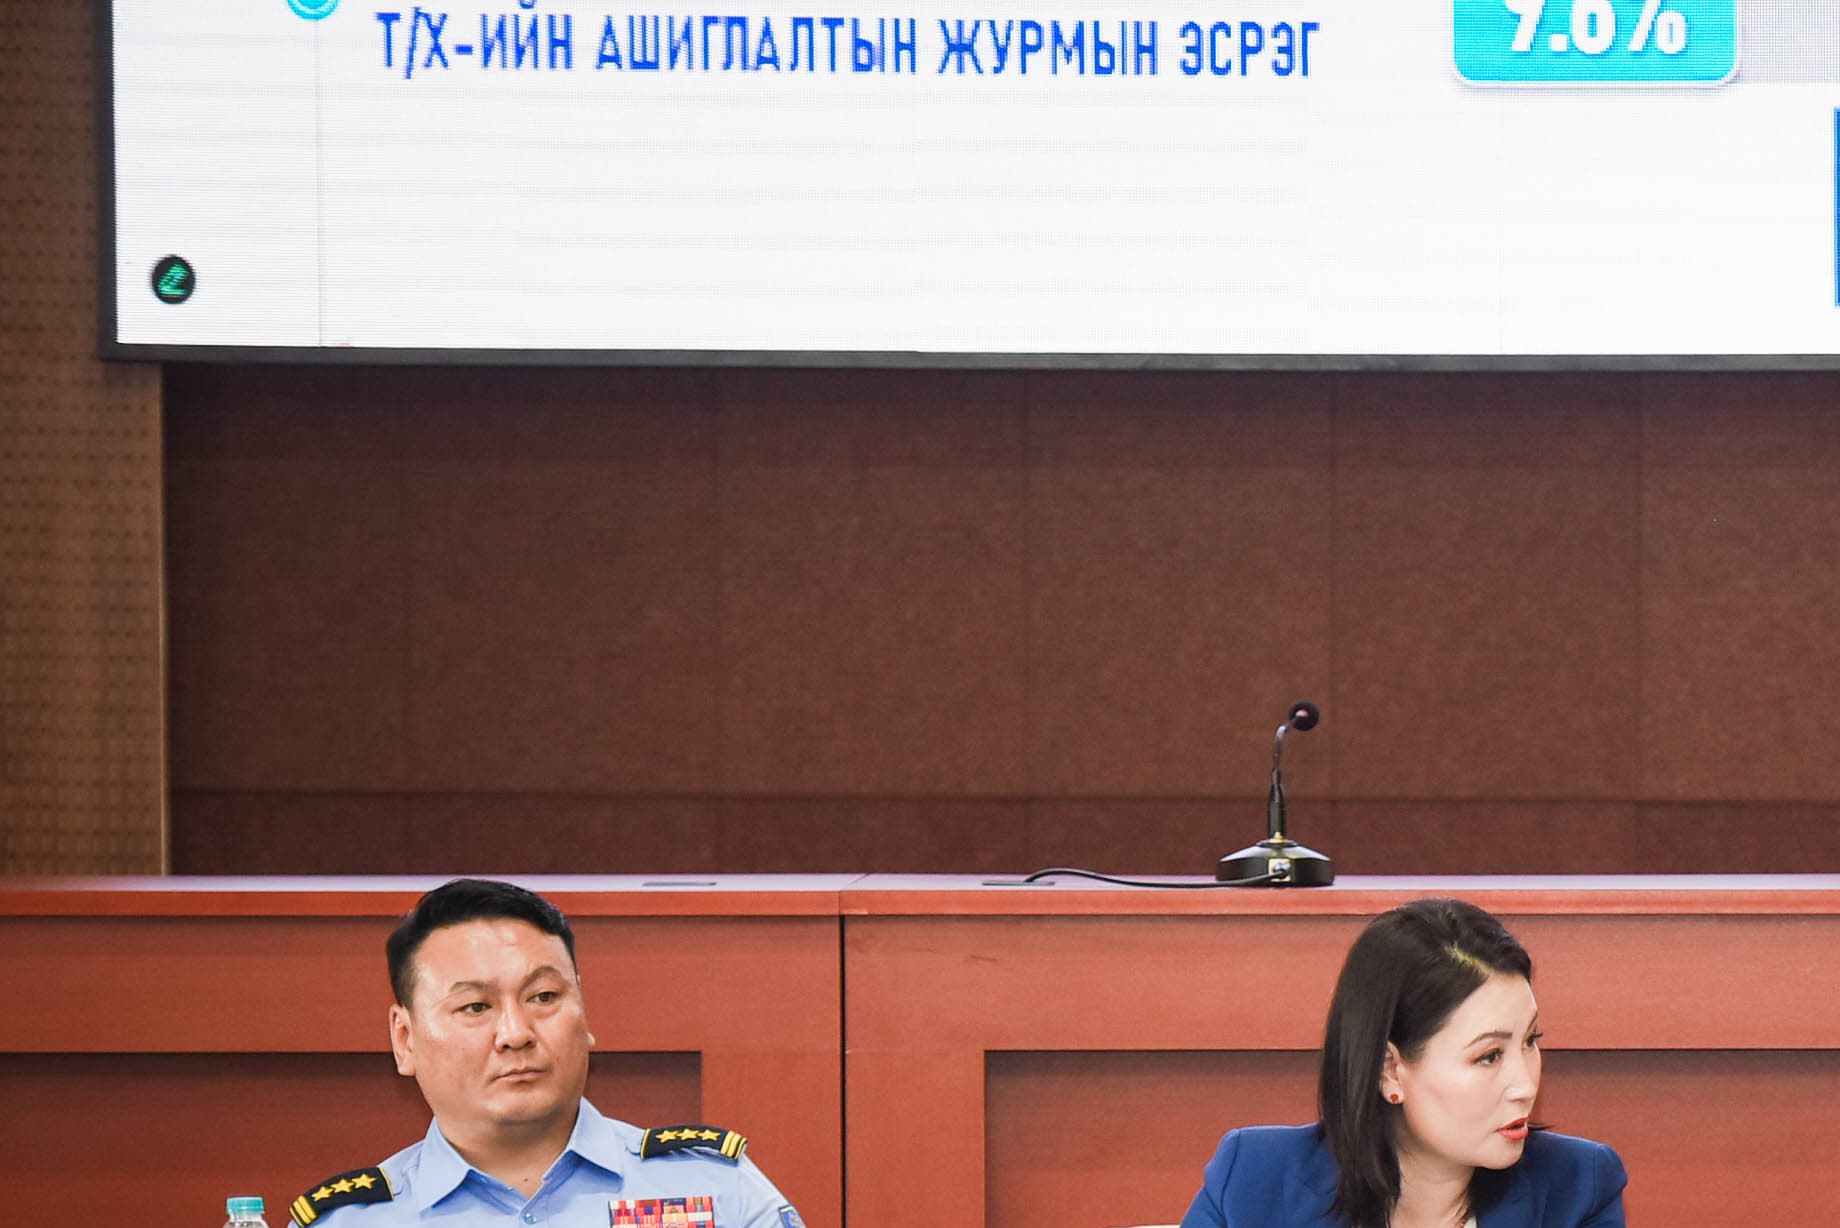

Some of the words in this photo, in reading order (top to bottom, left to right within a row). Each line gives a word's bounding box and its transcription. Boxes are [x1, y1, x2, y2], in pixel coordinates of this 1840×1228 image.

[595, 14, 917, 74] АШИГЛАЛТЫН
[936, 18, 1160, 76] ЖУРМЫН
[1178, 19, 1321, 78] ЭСРЭГ
